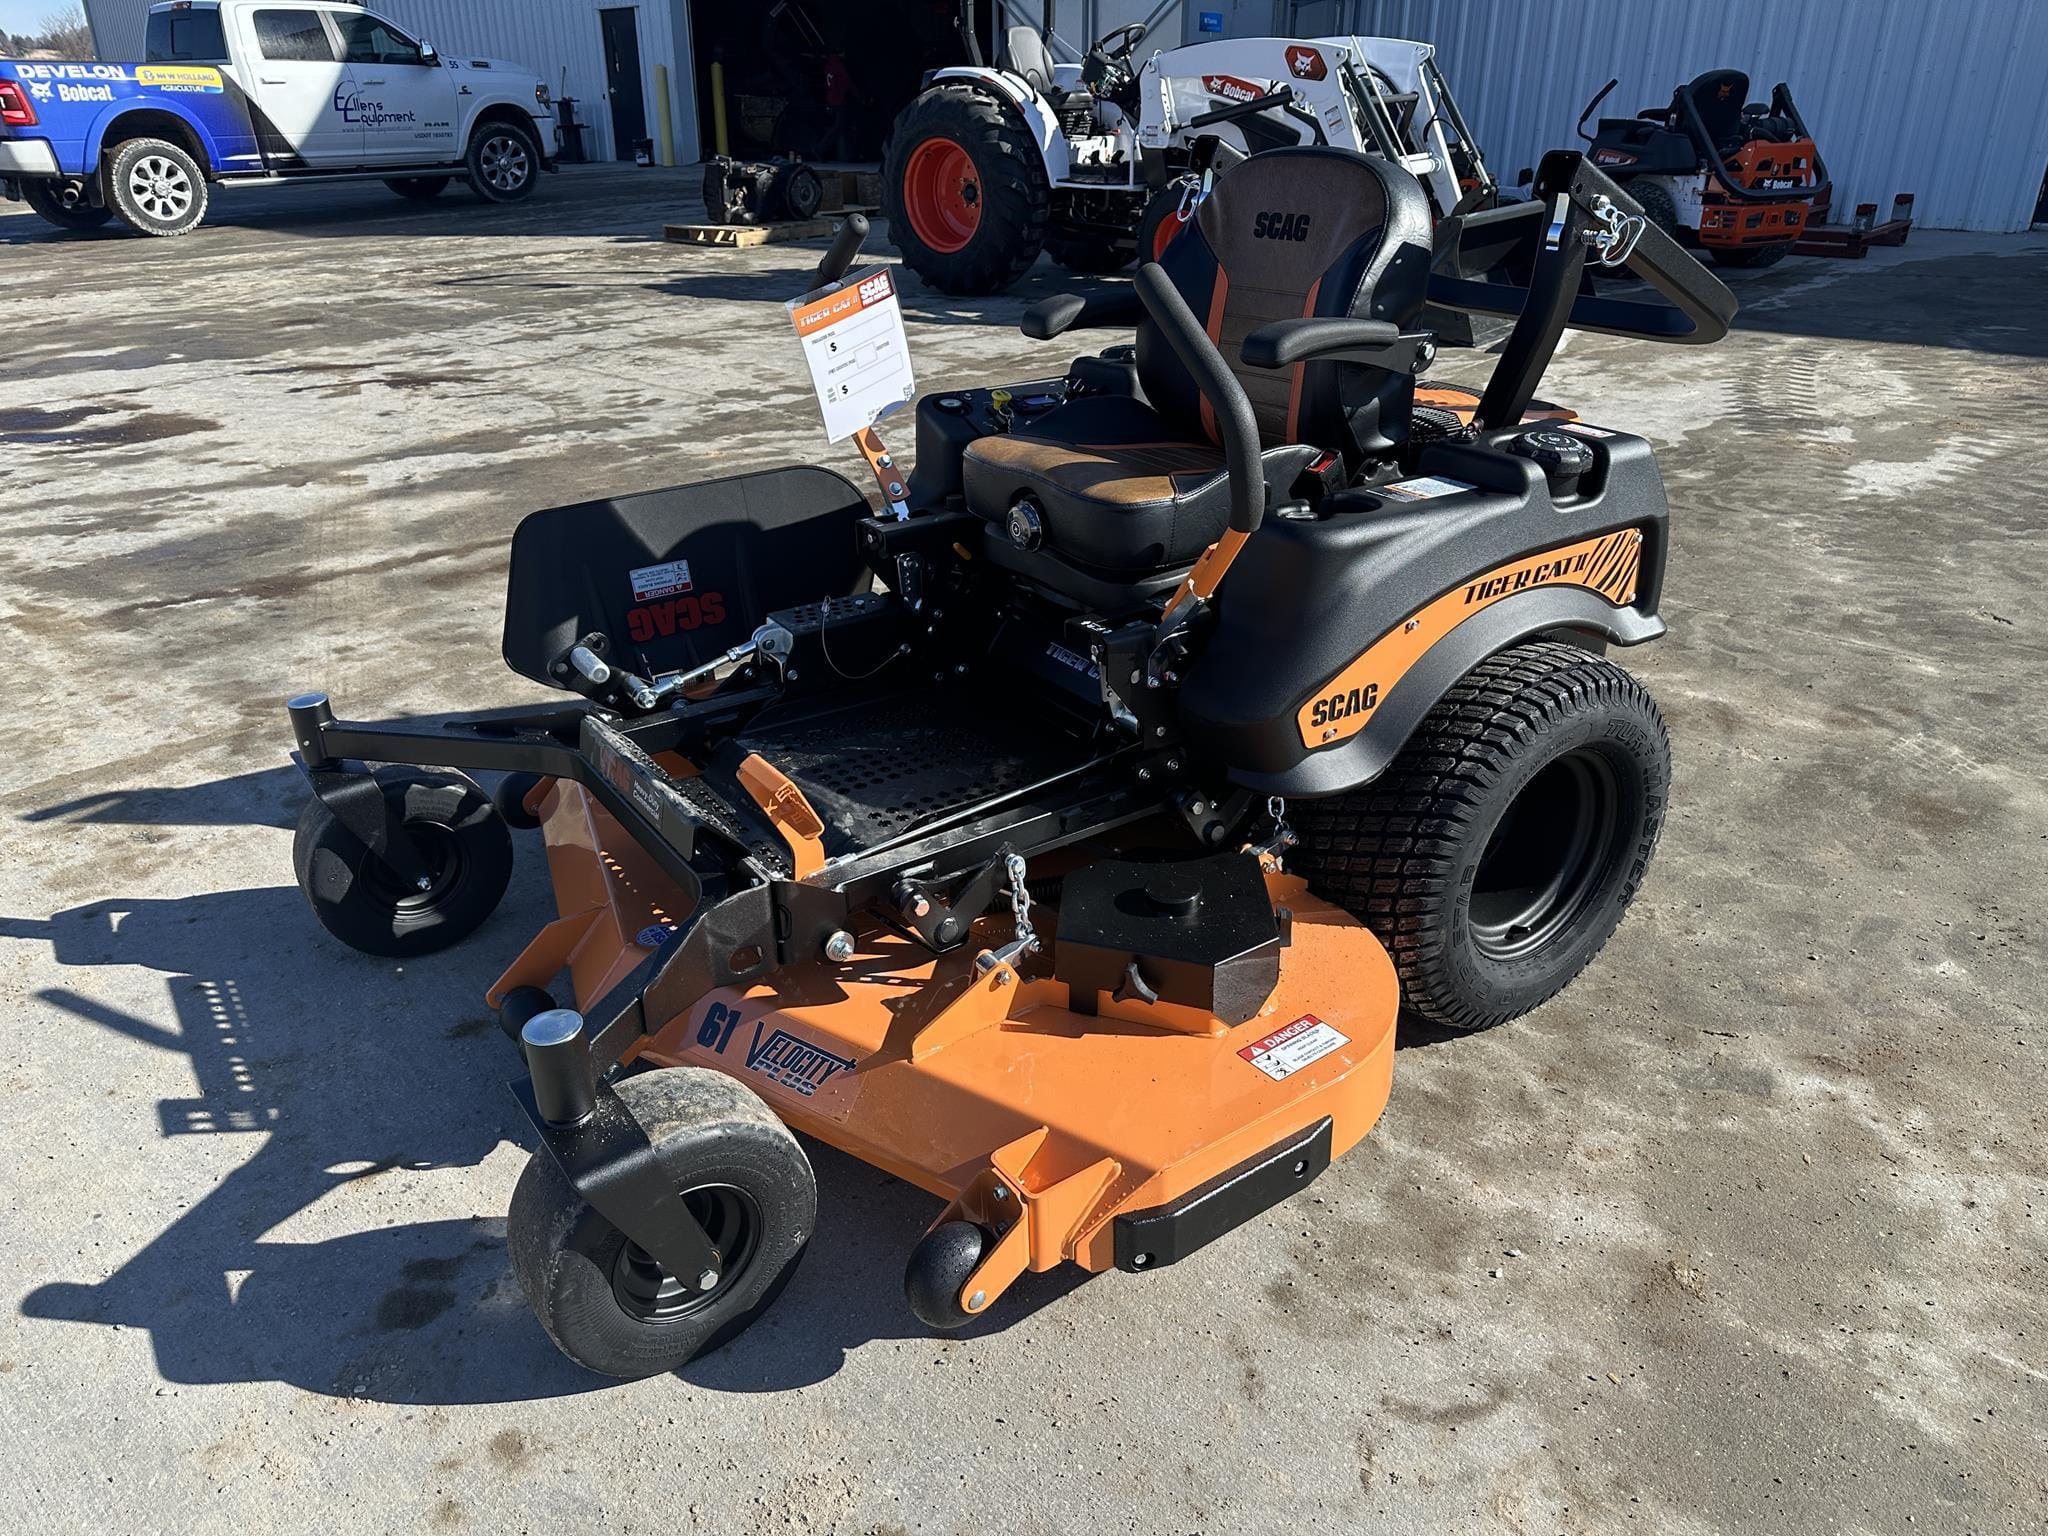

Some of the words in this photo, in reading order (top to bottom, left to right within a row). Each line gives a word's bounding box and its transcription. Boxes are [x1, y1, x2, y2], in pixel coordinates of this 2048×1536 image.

[15, 64, 127, 79] DEVELON
[176, 72, 215, 81] HOLLAND
[57, 83, 113, 102] Bobcat
[334, 80, 384, 112] Ellens
[1222, 82, 1256, 102] Bobcat
[343, 91, 417, 127] Equipment
[1253, 211, 1311, 242] SCAG
[859, 274, 890, 300] SCAG
[799, 307, 830, 328] TIGER
[832, 297, 852, 314] CAT
[830, 341, 837, 353] $
[841, 384, 849, 395] $
[644, 585, 675, 598] DANGER
[1463, 568, 1532, 606] TIGER
[1531, 555, 1577, 585] CAT
[626, 591, 727, 642] SCAG
[1311, 682, 1379, 728] SCAG
[697, 1001, 742, 1055] 61
[1264, 1019, 1314, 1048] DANGER
[751, 1056, 818, 1098] PLUS
